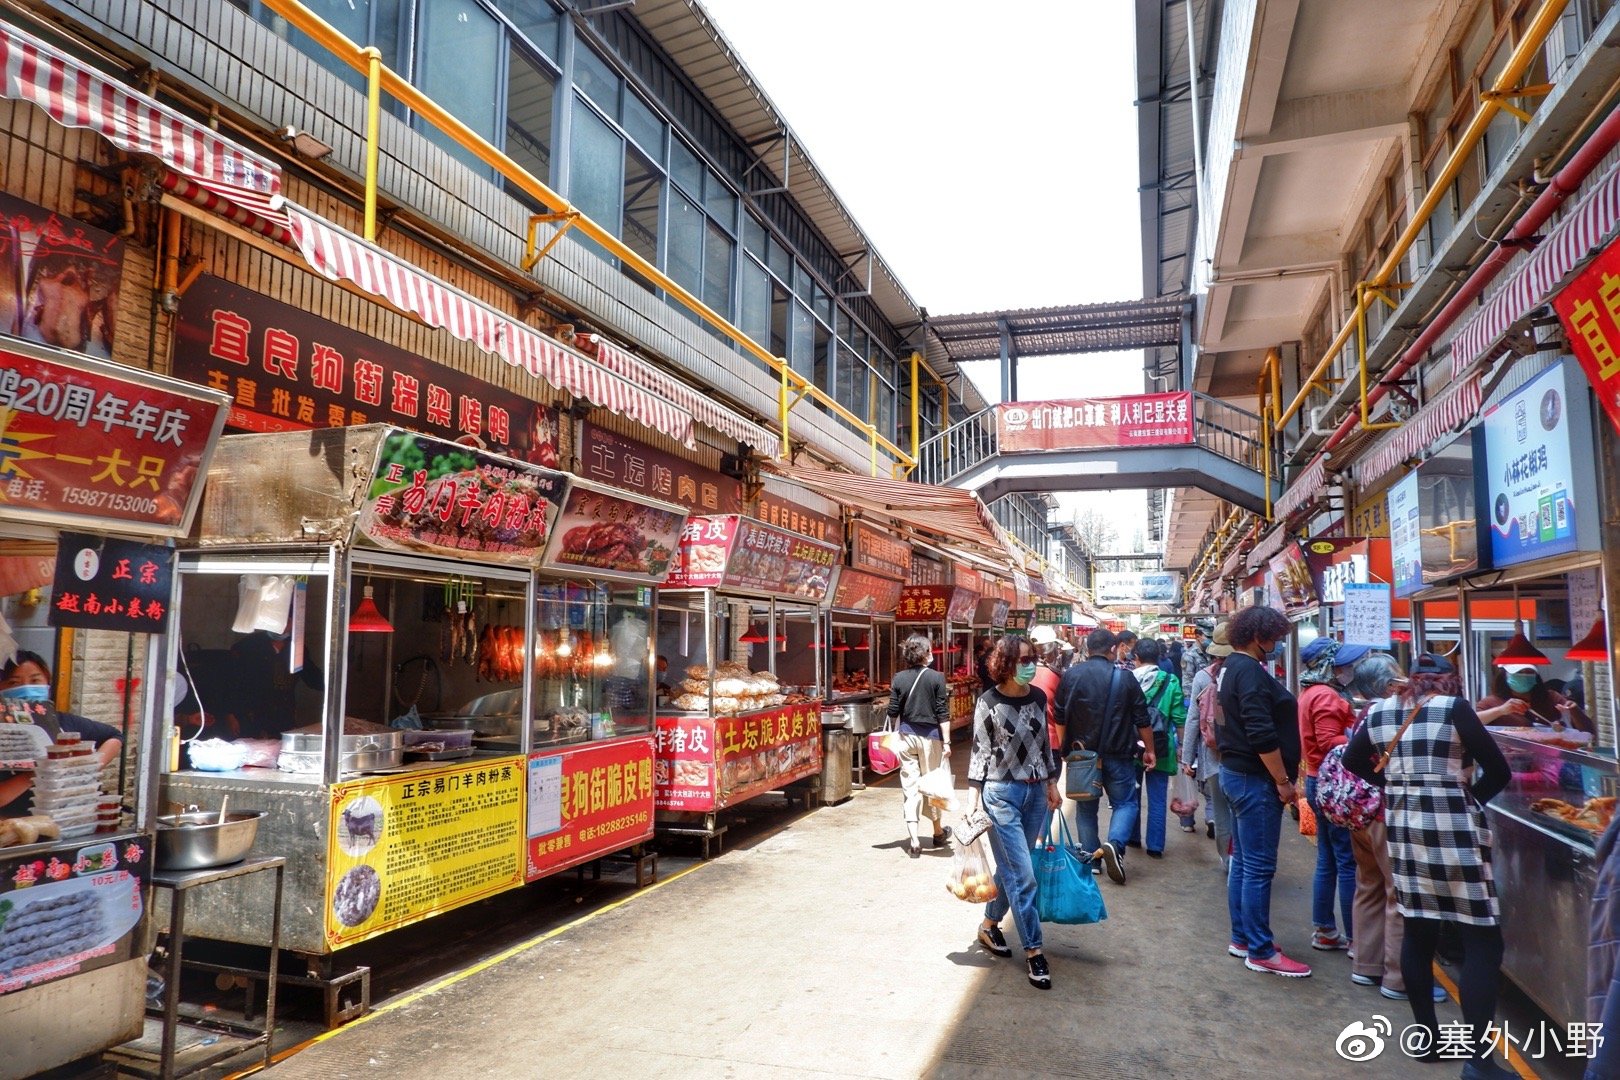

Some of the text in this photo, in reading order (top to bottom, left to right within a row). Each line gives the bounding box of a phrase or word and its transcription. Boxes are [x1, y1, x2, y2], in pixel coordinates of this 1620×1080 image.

[210, 308, 509, 446] 宜良狗街瑞梁烤鸭
[272, 387, 315, 424] 批发
[1111, 399, 1187, 426] 利人利己显关爱
[55, 449, 166, 492] 一大只
[591, 444, 718, 509] 土坛烤肉店
[1504, 444, 1547, 487] 小林花椒鸡
[62, 486, 158, 515] 15987153006
[374, 463, 405, 514] 正宗
[403, 468, 550, 536] 易门羊肉粉蒸
[112, 559, 160, 585] 正宗
[56, 592, 165, 620] 越南小卷粉
[723, 709, 817, 756] 土坛脆皮烤肉
[402, 766, 512, 799] 正宗易门羊肉粉蒸
